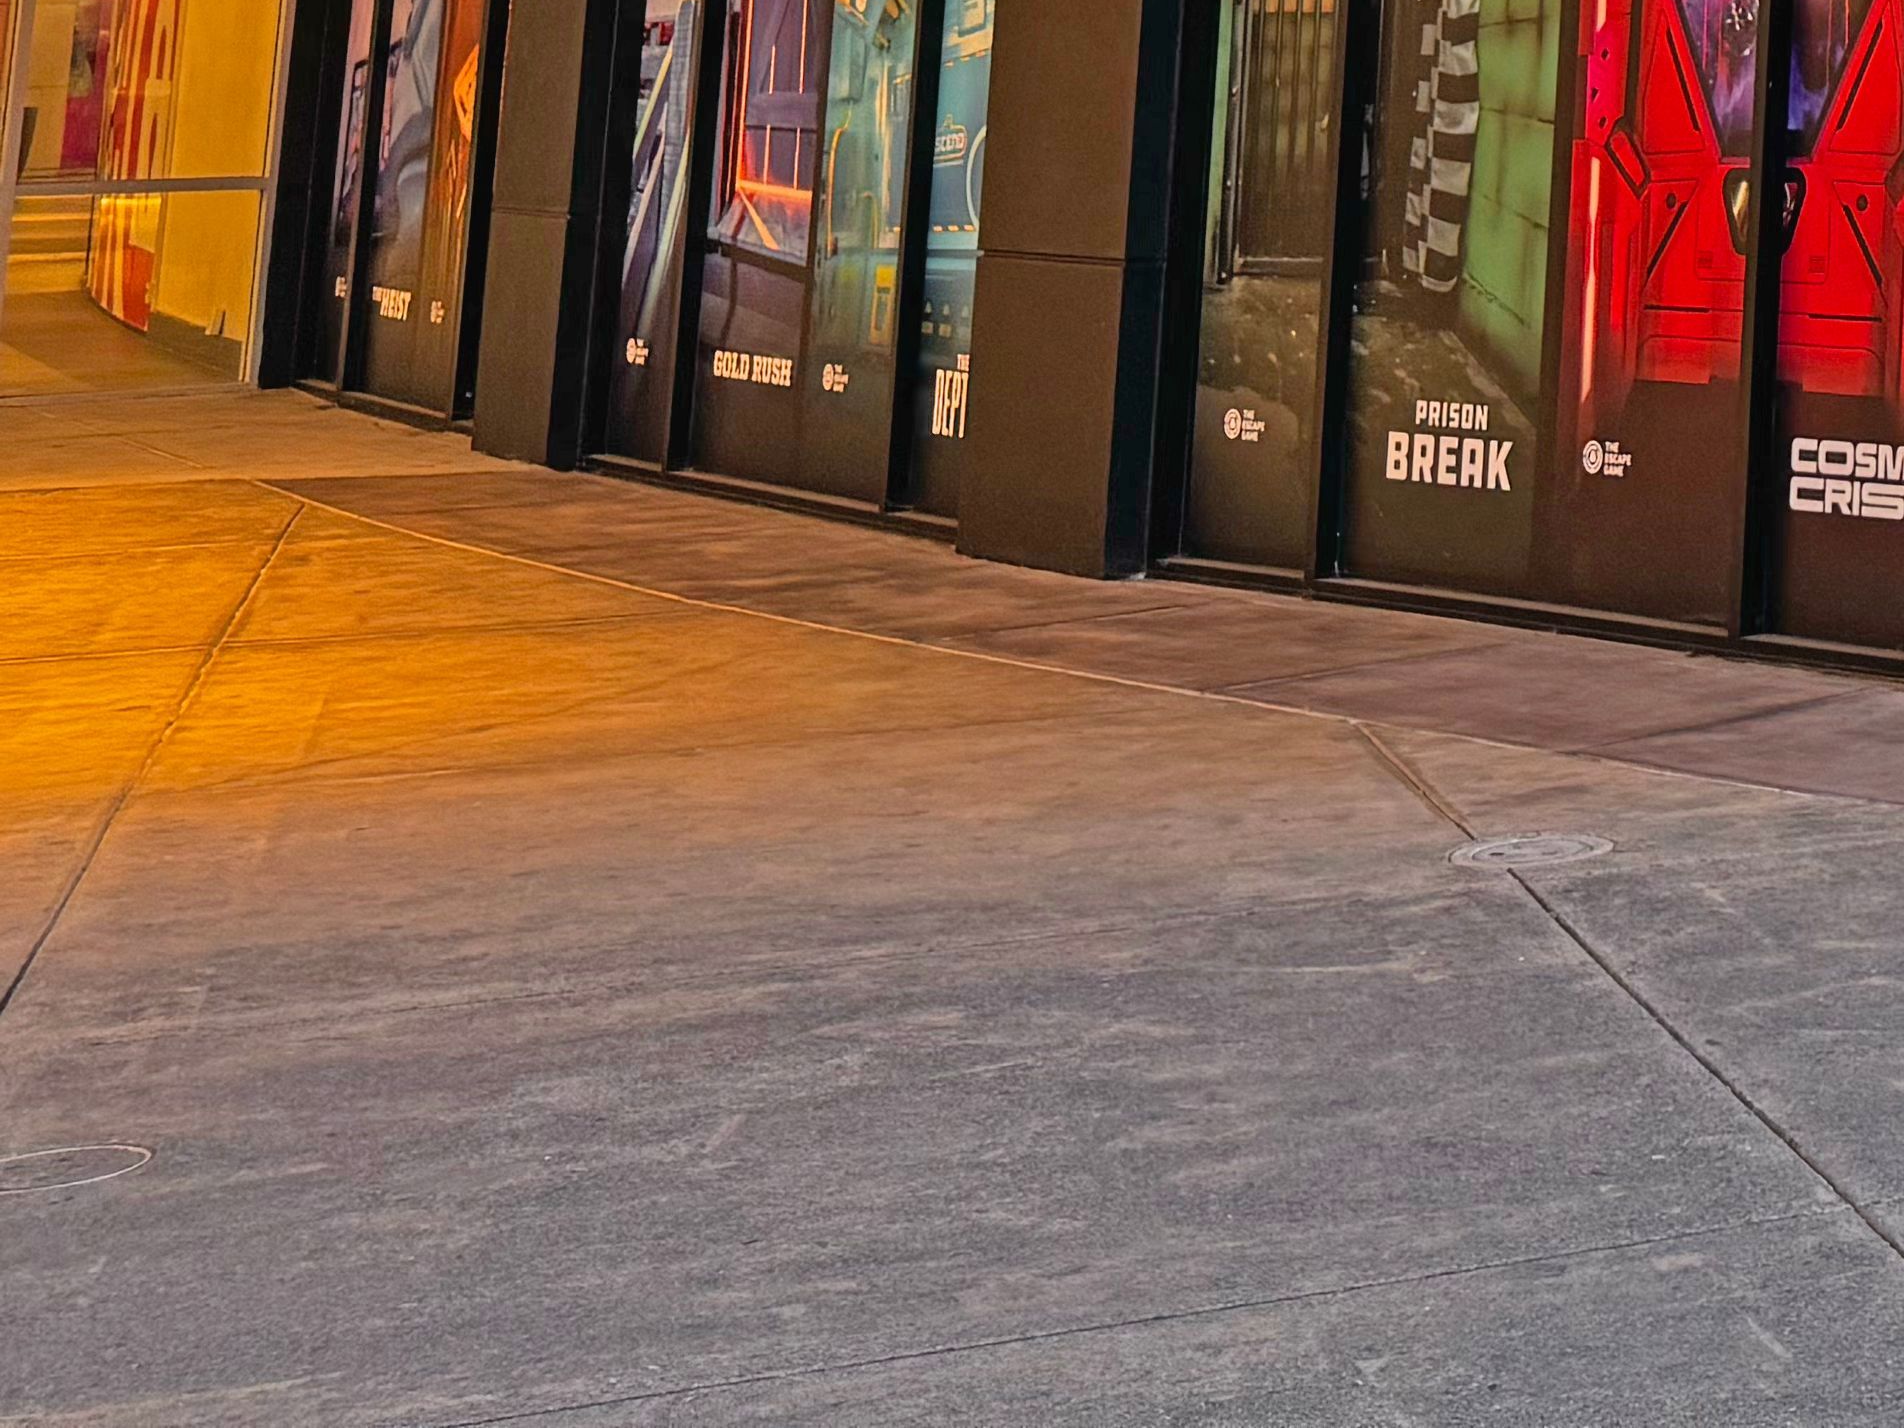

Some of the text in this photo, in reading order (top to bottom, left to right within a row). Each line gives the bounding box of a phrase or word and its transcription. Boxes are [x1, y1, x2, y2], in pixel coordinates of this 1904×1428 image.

[713, 350, 792, 387] GOLD RUSH
[1415, 400, 1489, 431] PRISON
[1386, 431, 1513, 491] BREAK
